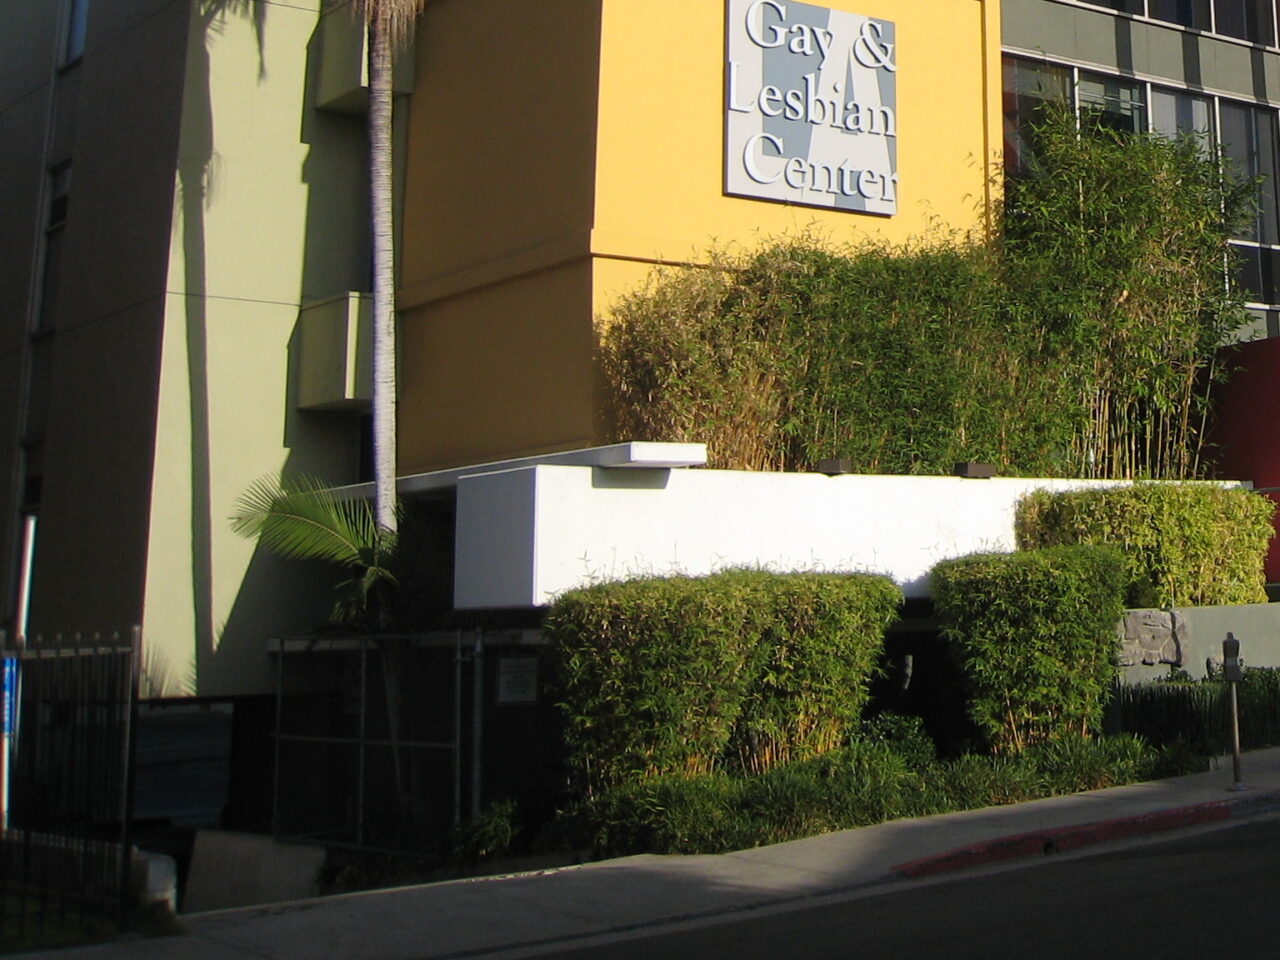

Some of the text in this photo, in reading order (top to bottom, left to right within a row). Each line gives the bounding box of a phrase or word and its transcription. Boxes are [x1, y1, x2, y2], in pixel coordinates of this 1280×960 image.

[746, 0, 898, 72] Gay &
[728, 60, 896, 137] Lesbian
[743, 132, 898, 202] Center
